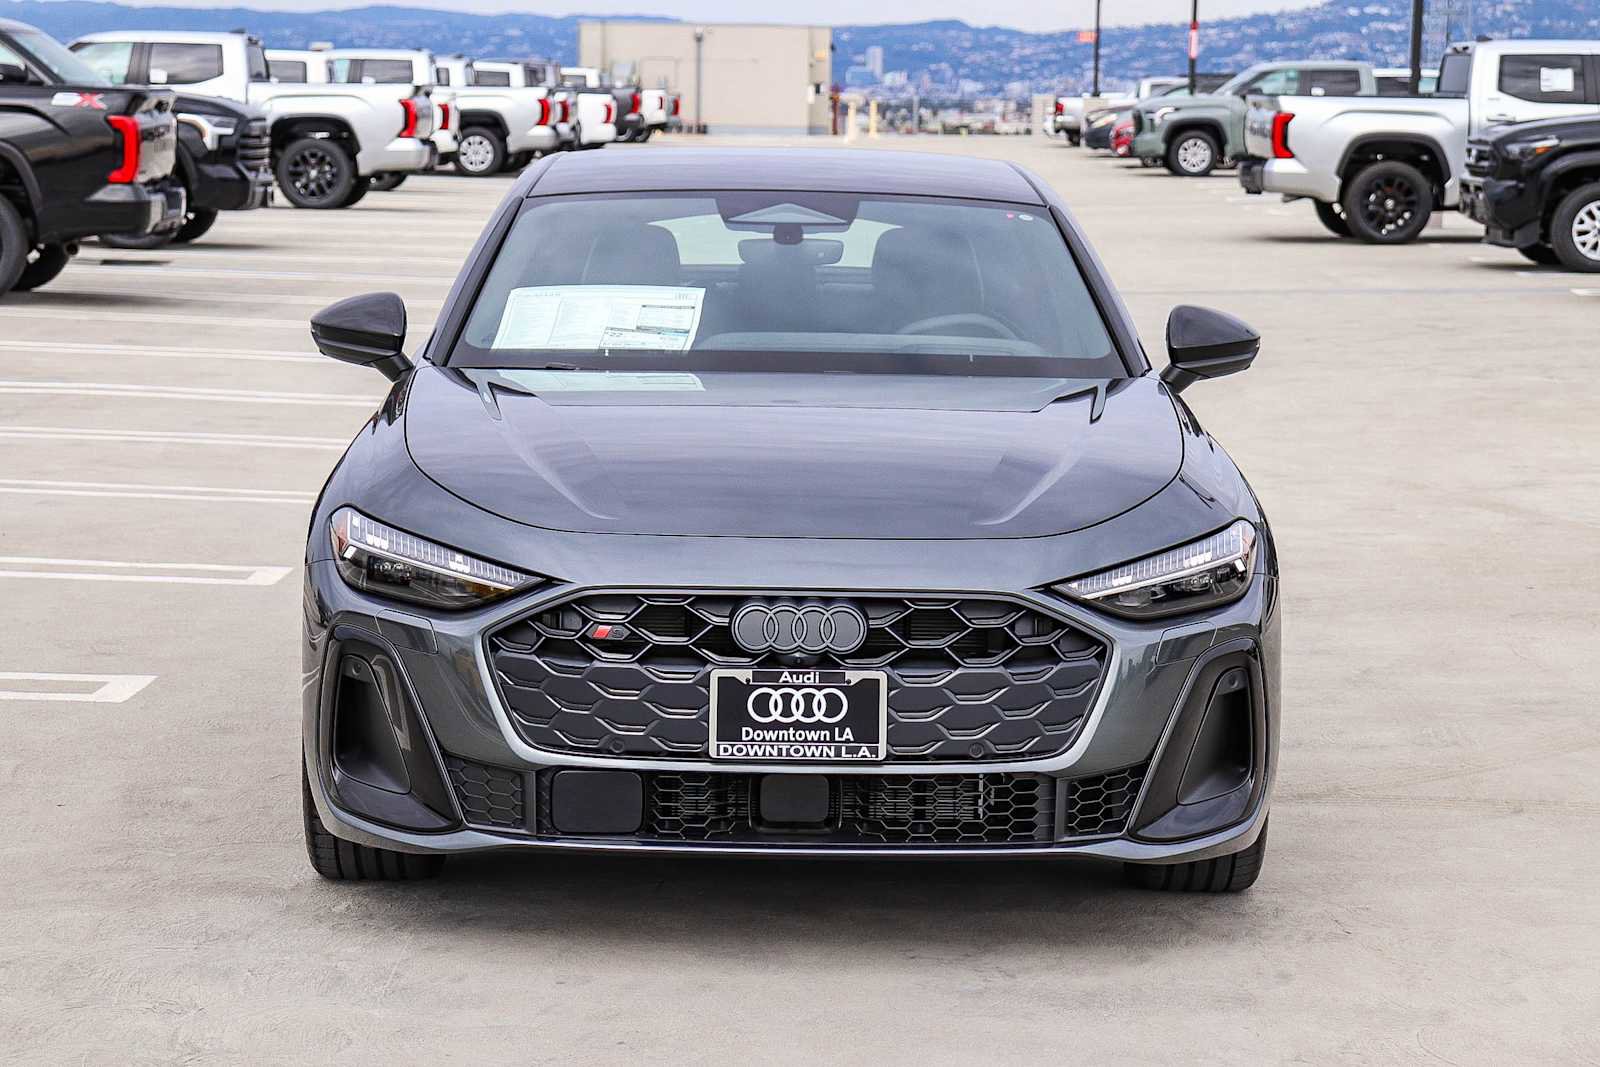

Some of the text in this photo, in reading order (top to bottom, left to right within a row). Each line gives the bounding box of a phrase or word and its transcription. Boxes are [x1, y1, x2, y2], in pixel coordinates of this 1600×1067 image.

[779, 671, 820, 684] Audi
[741, 727, 854, 742] Downtown LA
[719, 744, 876, 758] DOWNTOWN L.A.
